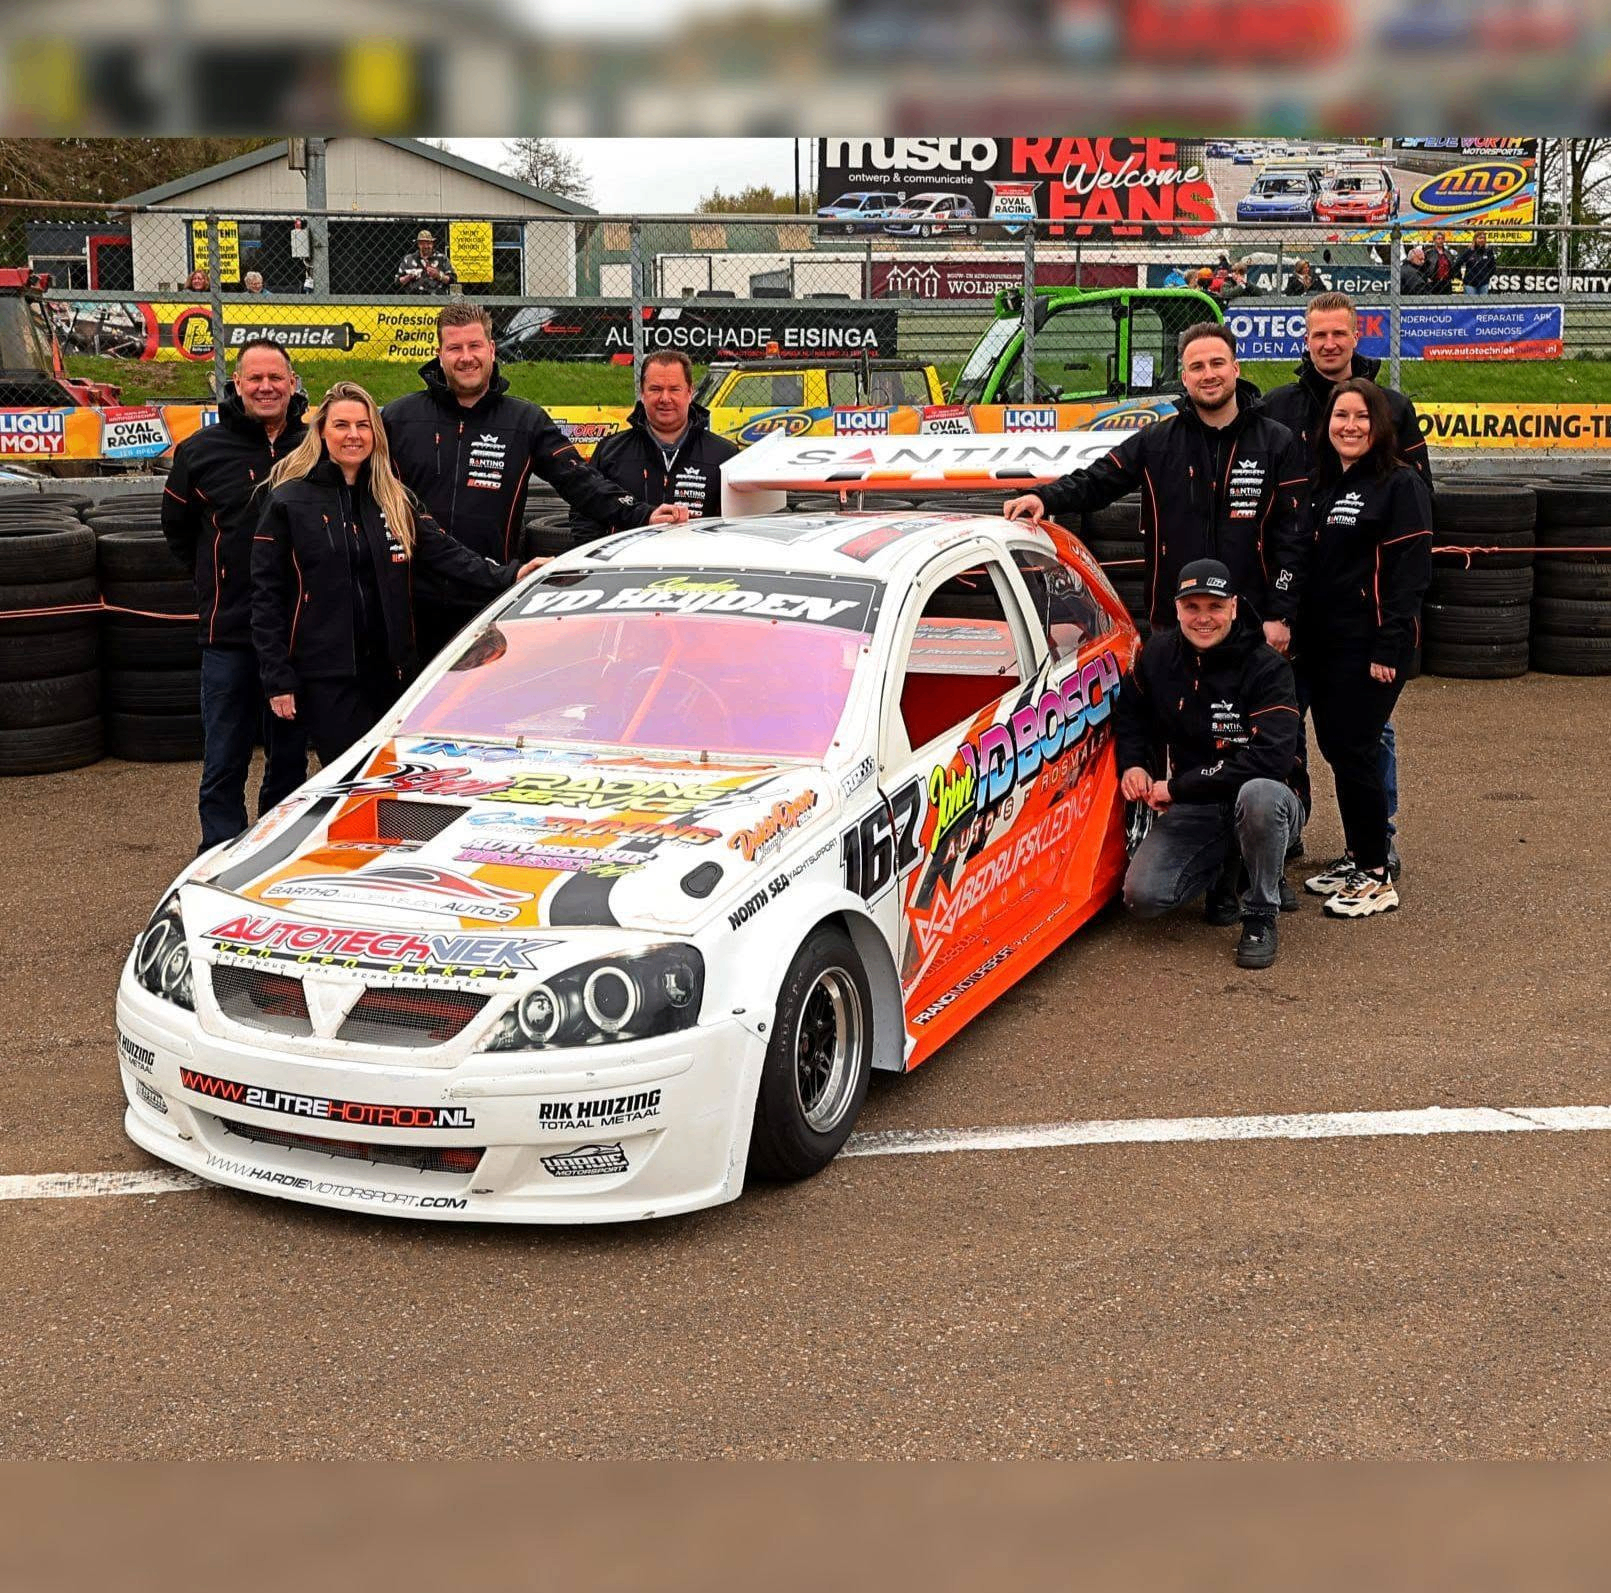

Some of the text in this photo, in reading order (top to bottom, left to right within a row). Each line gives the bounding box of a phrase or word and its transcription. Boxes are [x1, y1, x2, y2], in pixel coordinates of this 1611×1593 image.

[1012, 137, 1179, 173] RACE
[848, 172, 974, 185] ontwerp & communicatie
[1063, 150, 1204, 194] Welcome
[995, 205, 1032, 214] RACING
[1000, 197, 1027, 206] OVAL
[1049, 182, 1216, 236] FANS
[1488, 275, 1521, 290] RSS
[1400, 313, 1552, 324] NDERHOUD REPARATIE APK
[395, 329, 435, 343] Racing
[605, 326, 878, 347] AUTOSCHADE EISINGA
[1399, 327, 1522, 337] CHADEHERSTEL DIAGNOSE
[1253, 342, 1284, 353] DEN
[1, 414, 61, 433] LIQUI
[114, 422, 154, 435] OVAL
[836, 413, 886, 429] LIQUI
[929, 419, 963, 431] OVAL
[1006, 411, 1055, 427] LIQUI
[1, 434, 63, 453] MOLY
[107, 432, 163, 448] RACING
[519, 590, 605, 615] VD
[929, 764, 975, 854] John
[840, 775, 926, 910] 167
[955, 781, 1093, 917] BEDRIJFSKLEDING
[267, 886, 340, 897] BARTHO
[728, 888, 769, 931] NORTH
[767, 872, 790, 899] SEA
[217, 941, 517, 980] van den akker
[121, 1034, 155, 1066] HUIZING
[180, 1069, 474, 1127] WWW.2LITREHOTROD.NL
[539, 1088, 662, 1120] RIK HUIZING
[539, 1106, 661, 1130] TOTAAL METAAL
[205, 1152, 468, 1210] WWW.HARDIEMOTORSPORT.COM
